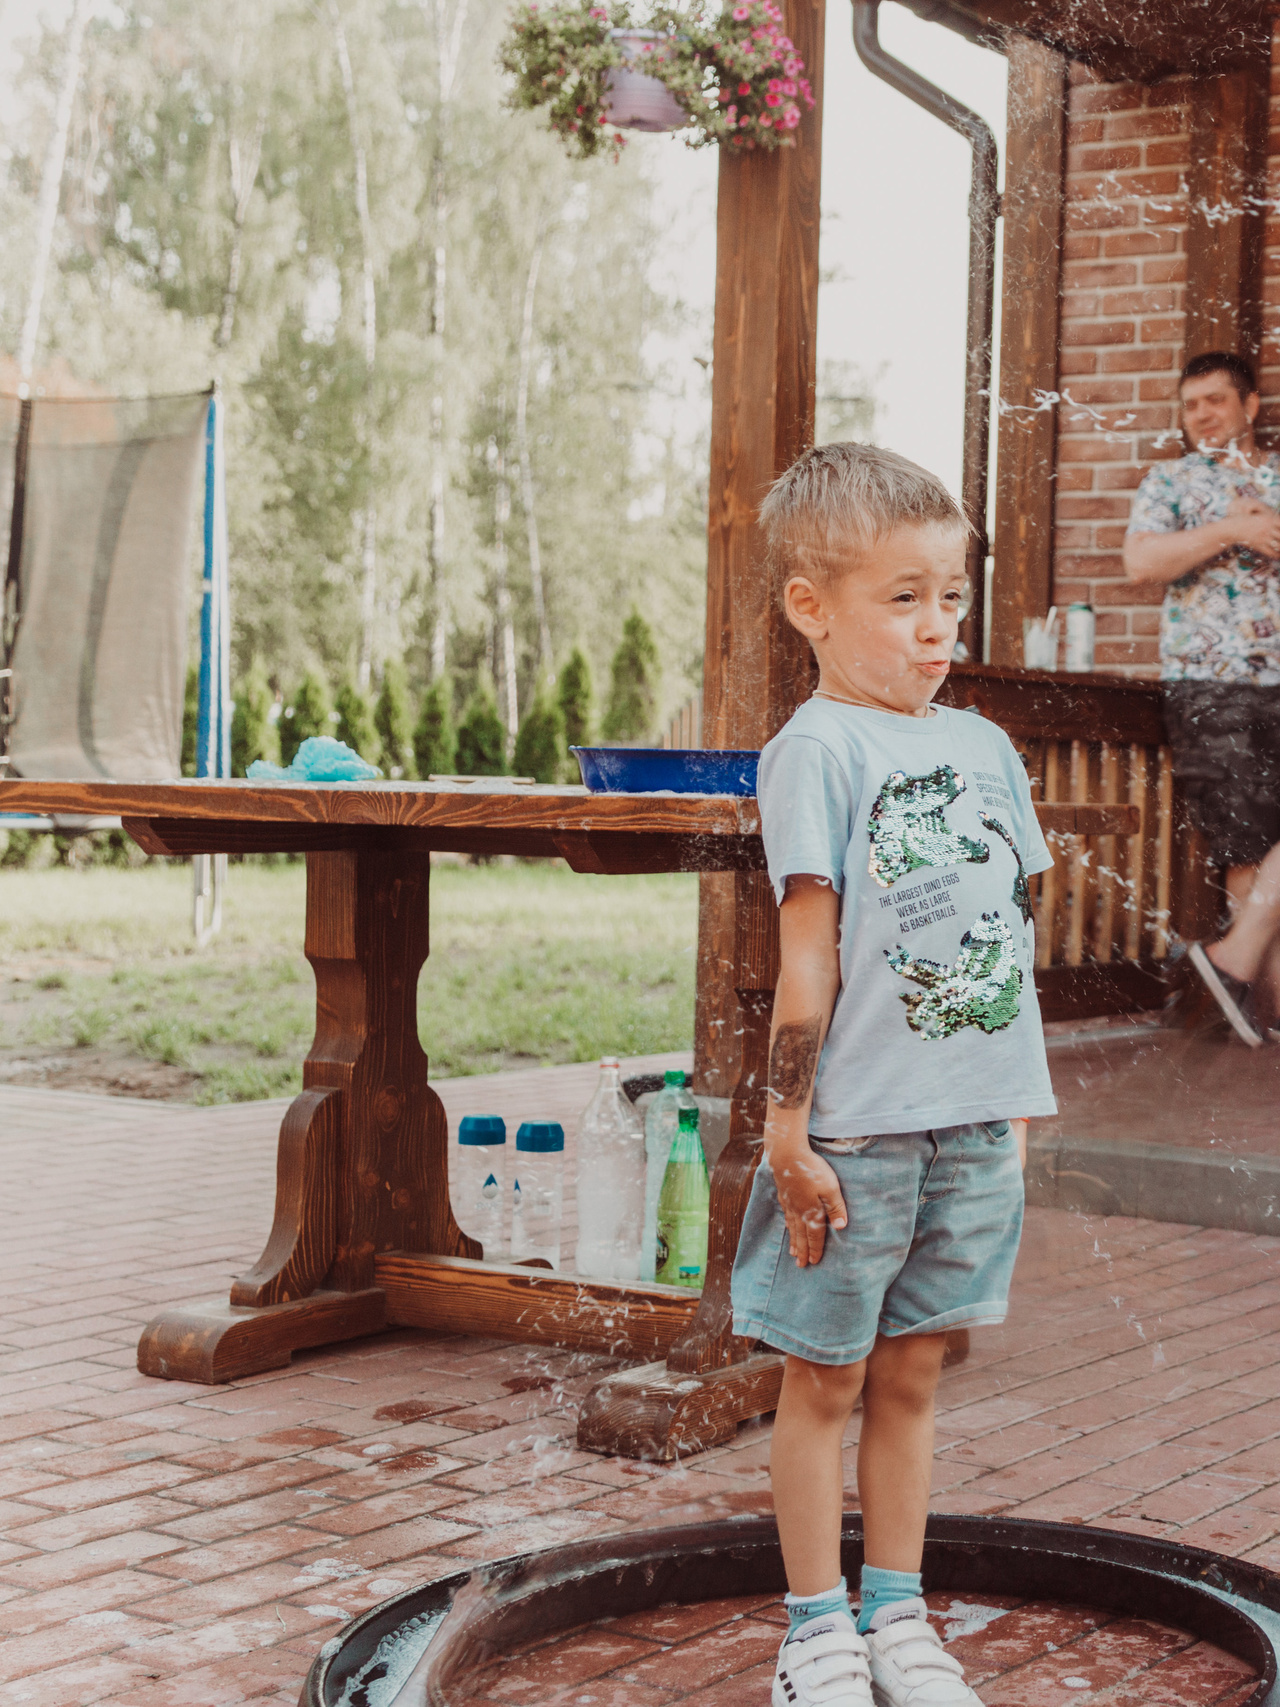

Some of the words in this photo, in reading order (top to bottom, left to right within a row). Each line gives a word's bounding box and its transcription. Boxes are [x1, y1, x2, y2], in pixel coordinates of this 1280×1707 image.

[878, 894, 893, 908] THE
[892, 885, 924, 904] LARGEST
[923, 878, 942, 894] DINO
[941, 872, 960, 887] EGGS
[896, 902, 919, 918] WERE
[919, 899, 929, 911] AS
[929, 890, 952, 907] LARGE
[899, 921, 910, 934] AS
[909, 904, 959, 930] BASKETBALLS.
[890, 1613, 917, 1624] adidas
